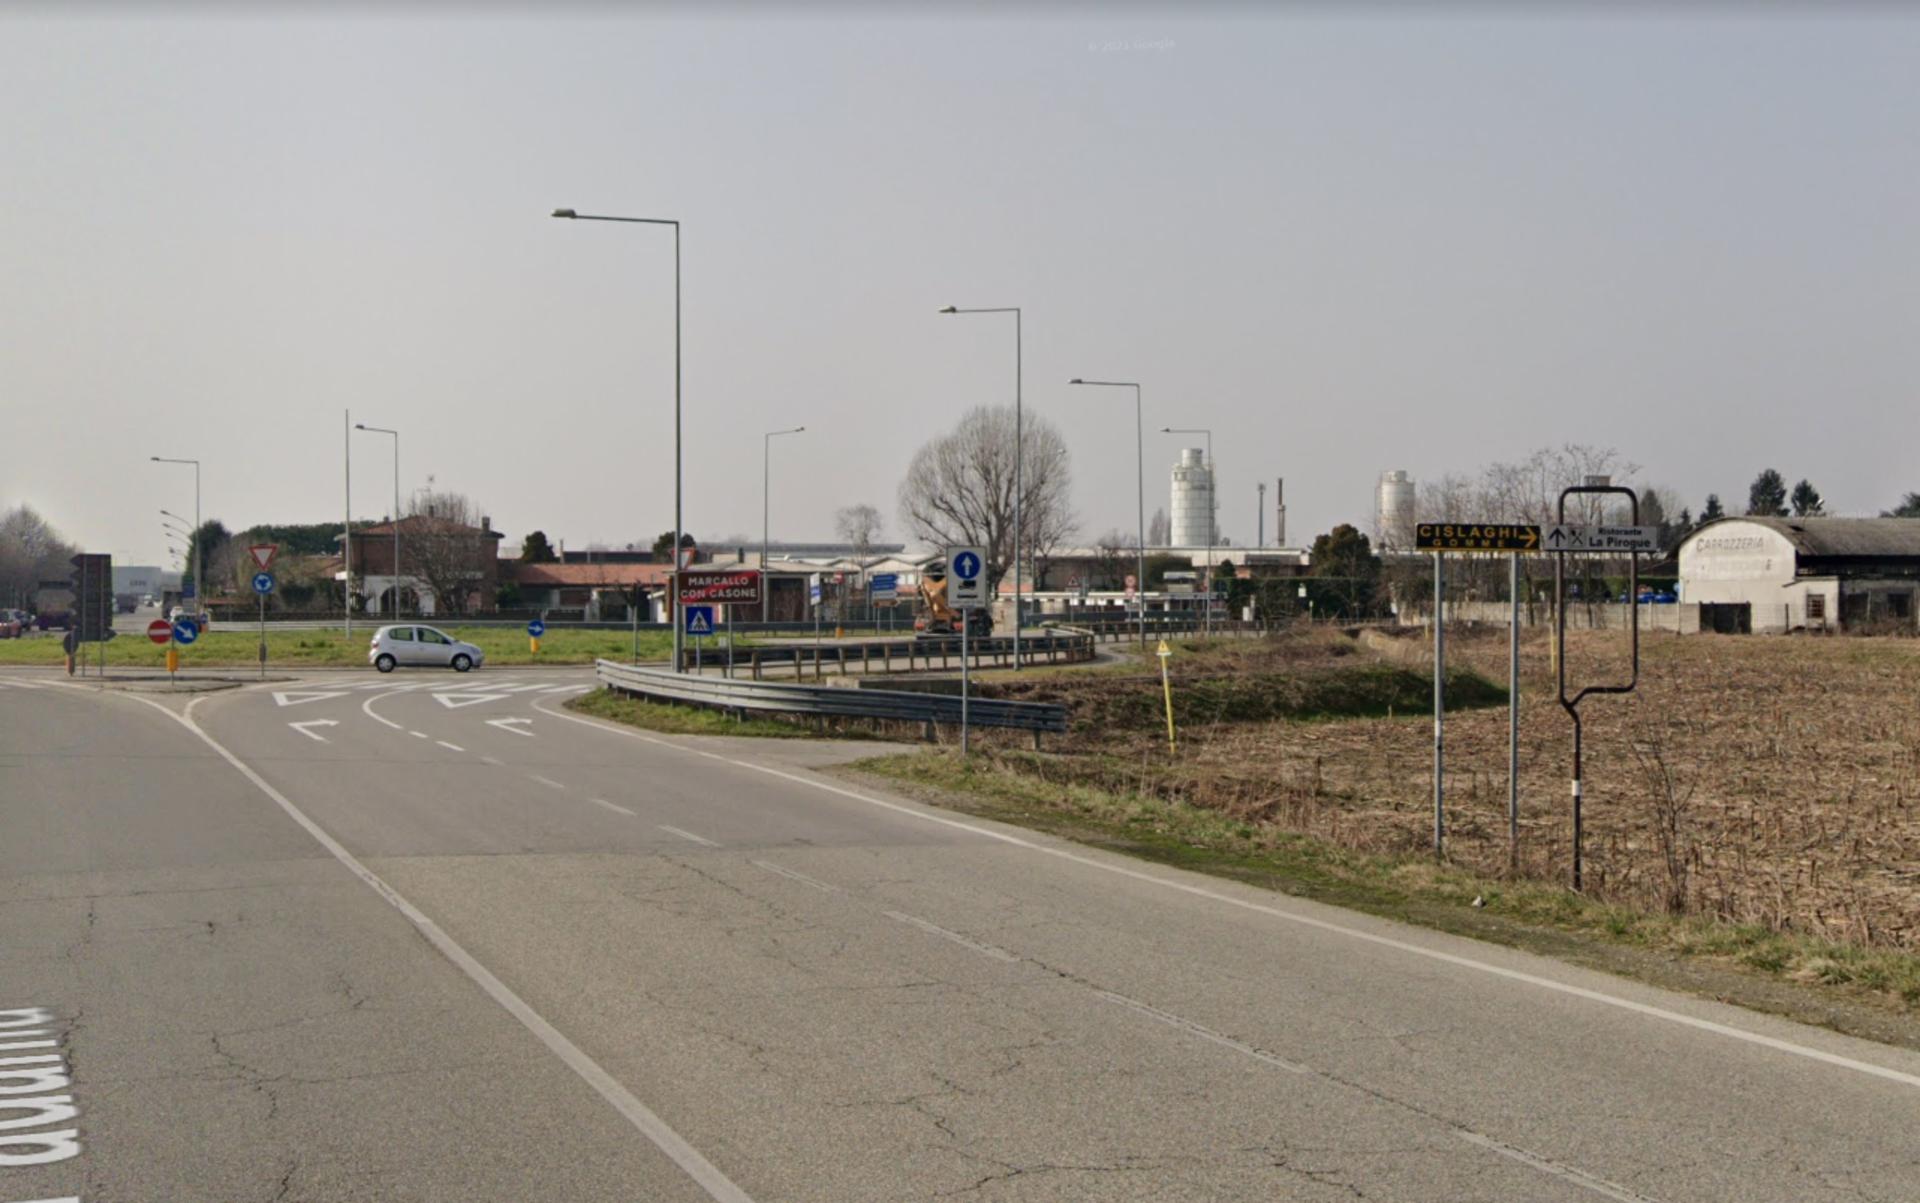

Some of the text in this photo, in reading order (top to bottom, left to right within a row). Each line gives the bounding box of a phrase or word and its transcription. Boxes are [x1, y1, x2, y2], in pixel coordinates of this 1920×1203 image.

[1420, 525, 1517, 538] CISLAGHI
[1432, 538, 1505, 547] GOMME
[1589, 537, 1651, 549] La Pirogue
[688, 576, 749, 586] MARCALLO
[681, 588, 757, 599] CON CASONE
